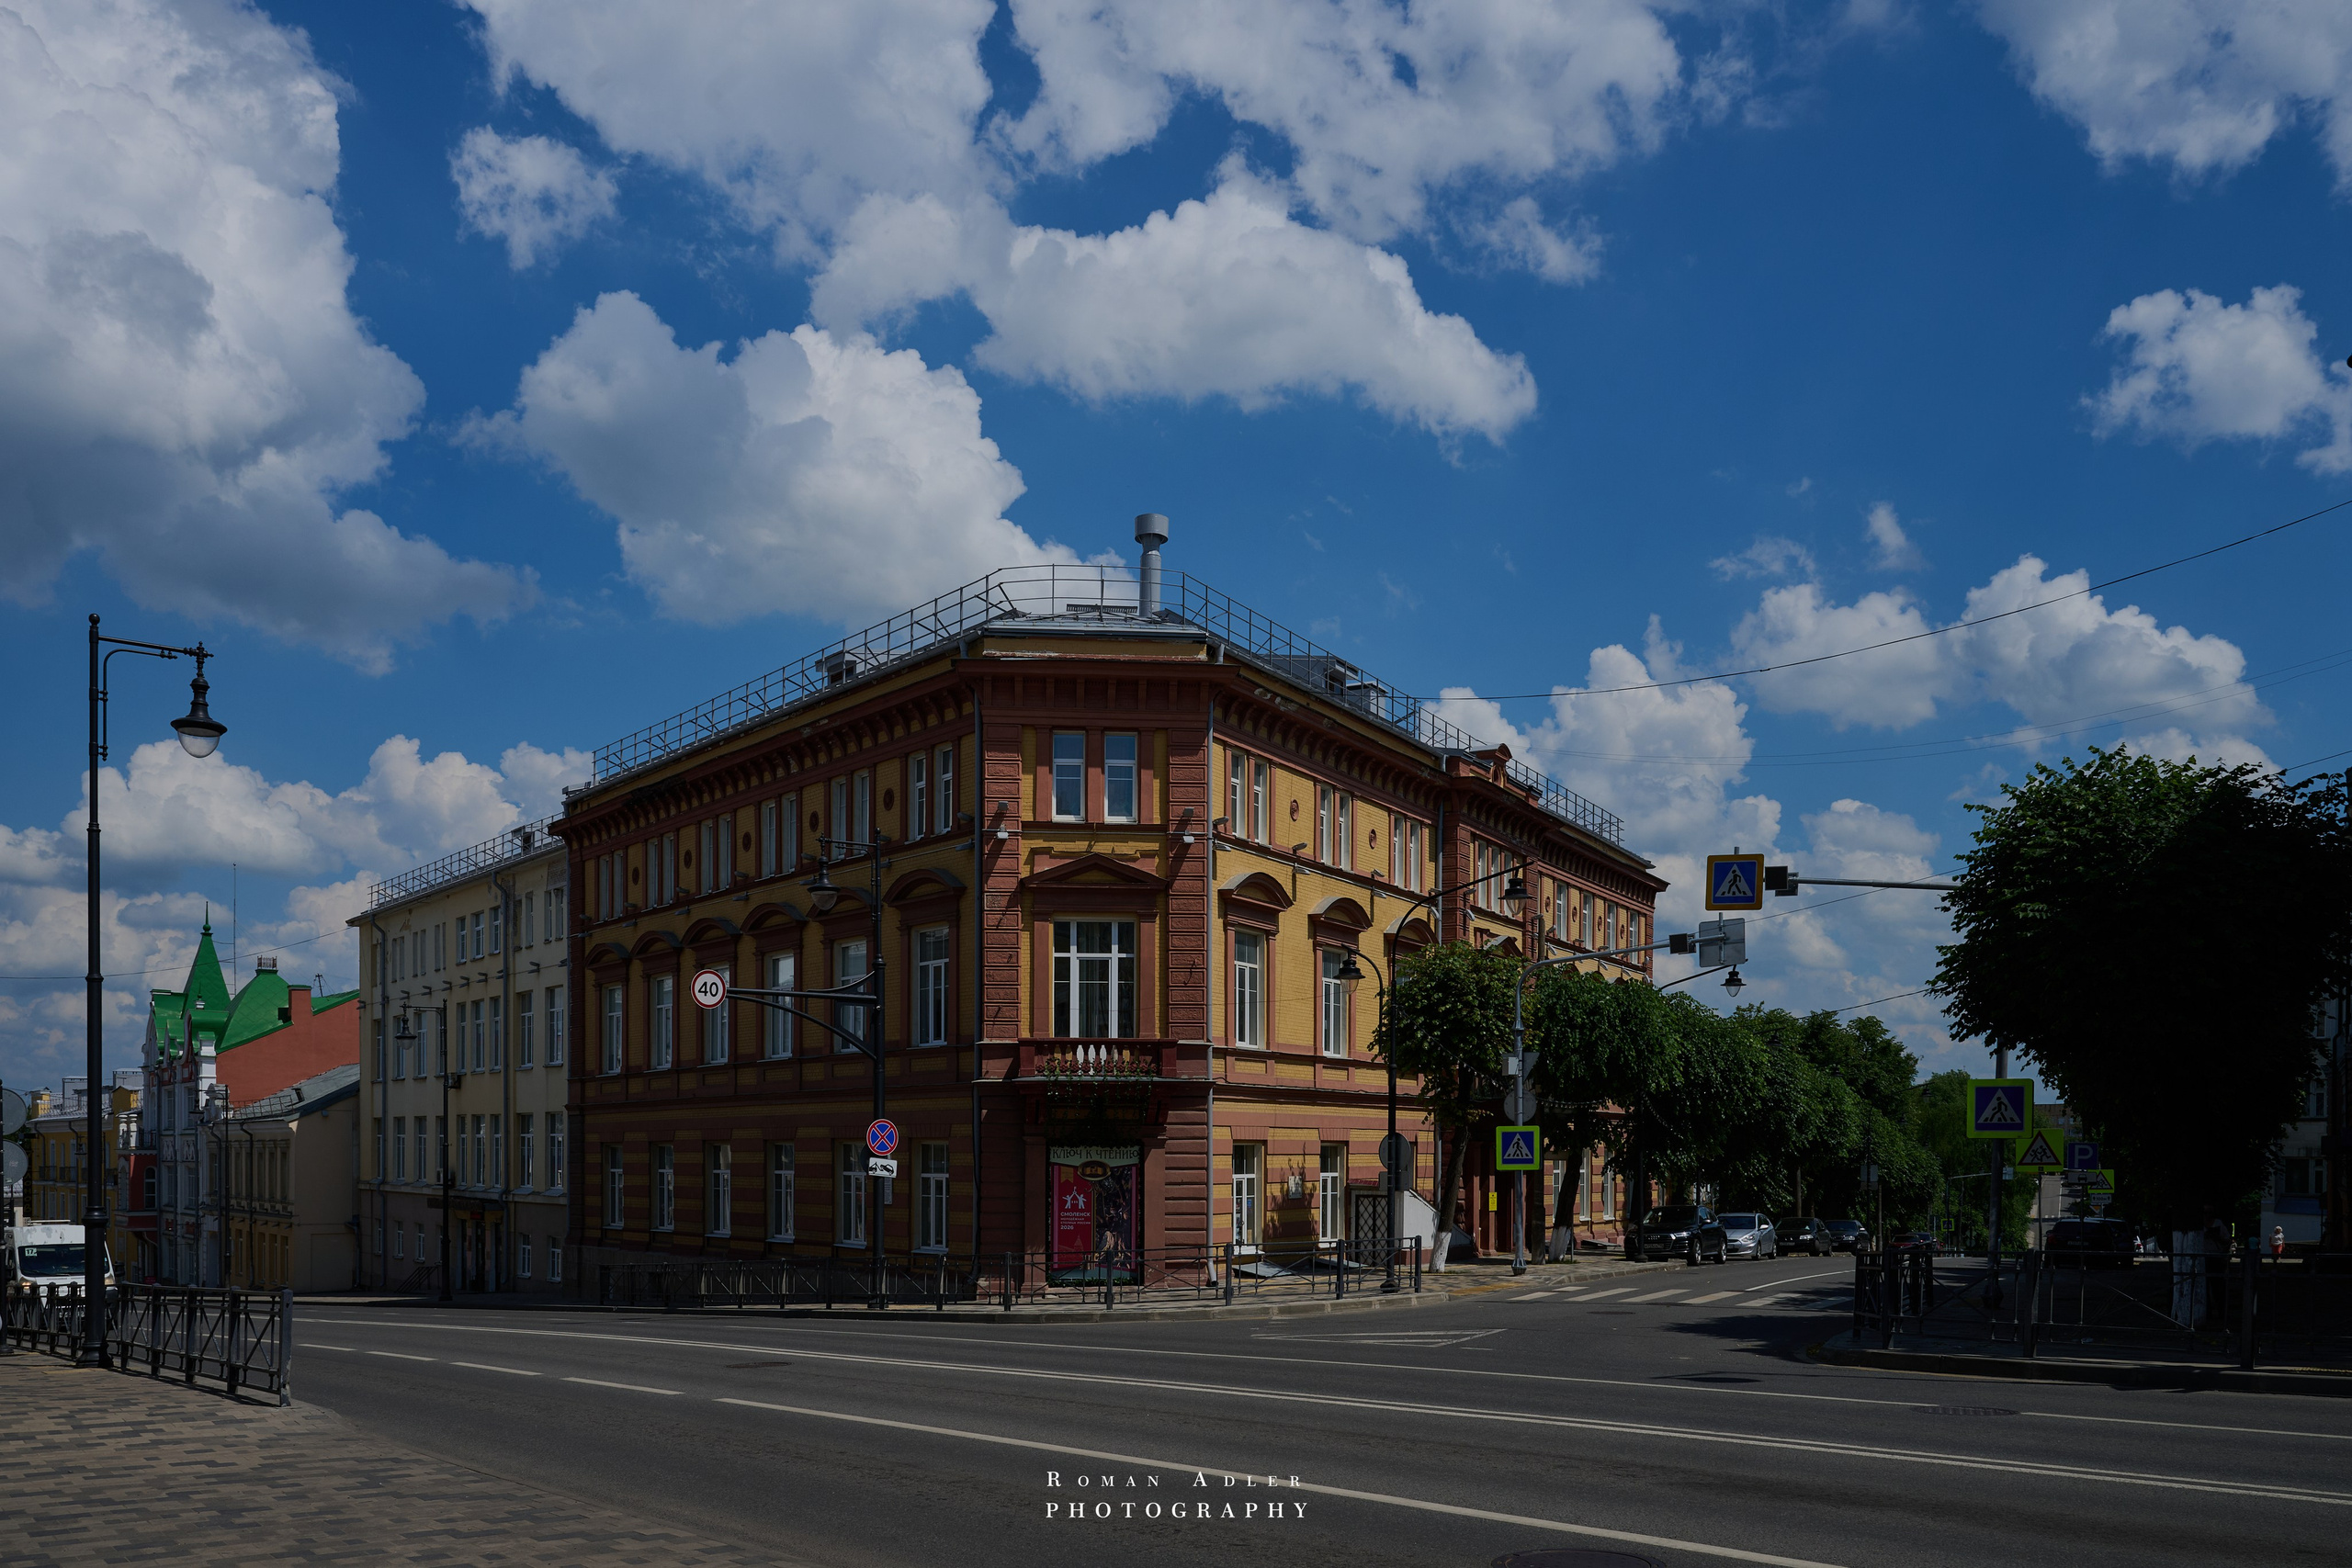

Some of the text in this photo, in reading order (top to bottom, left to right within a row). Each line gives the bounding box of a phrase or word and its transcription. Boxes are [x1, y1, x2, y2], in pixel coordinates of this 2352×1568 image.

[697, 981, 718, 997] 40
[1052, 1148, 1139, 1159] КЛЮЧ К ЧТЕНИЮ
[2074, 1144, 2094, 1168] P
